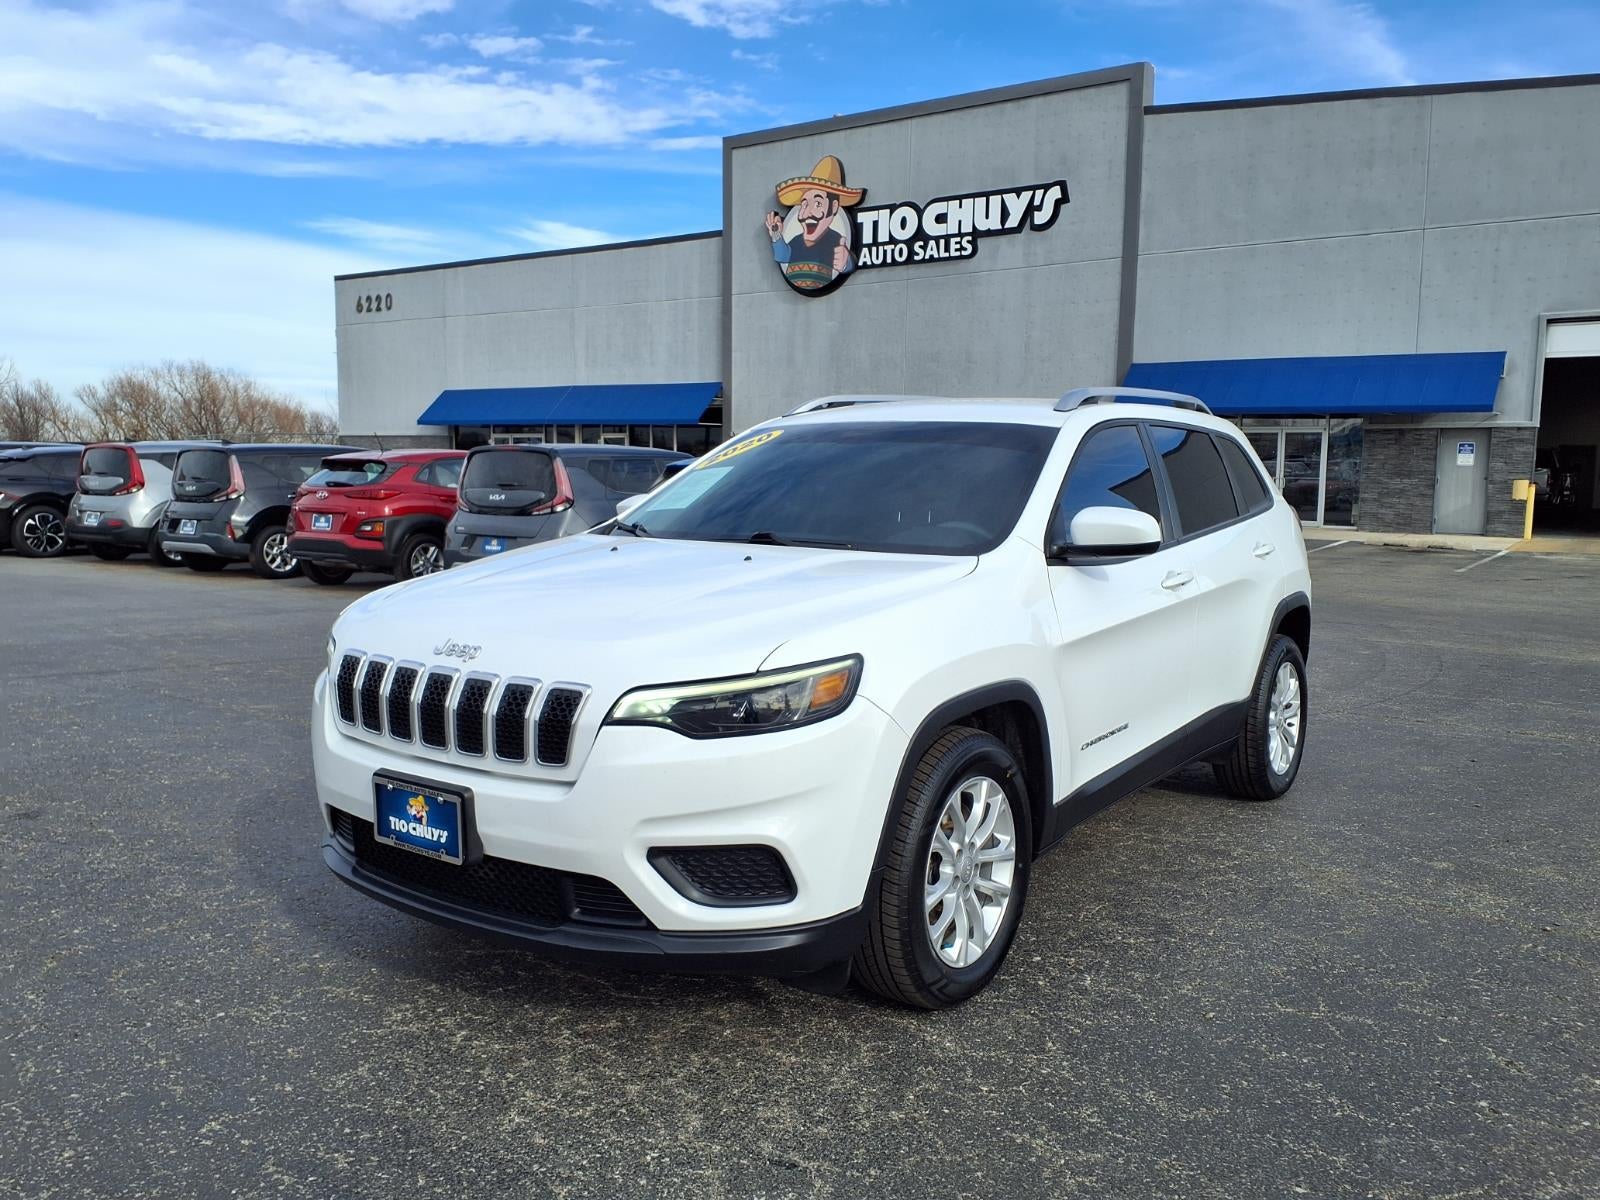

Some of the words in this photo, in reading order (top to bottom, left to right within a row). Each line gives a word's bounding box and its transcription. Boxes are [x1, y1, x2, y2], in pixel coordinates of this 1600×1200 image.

[857, 206, 919, 244] TIO
[922, 185, 1062, 237] CHUY'S
[858, 243, 908, 267] AUTO
[913, 236, 973, 261] SALES
[356, 292, 393, 314] 6220
[433, 638, 482, 663] Jeep
[389, 816, 408, 833] TIO
[408, 822, 448, 844] CHUY'S
